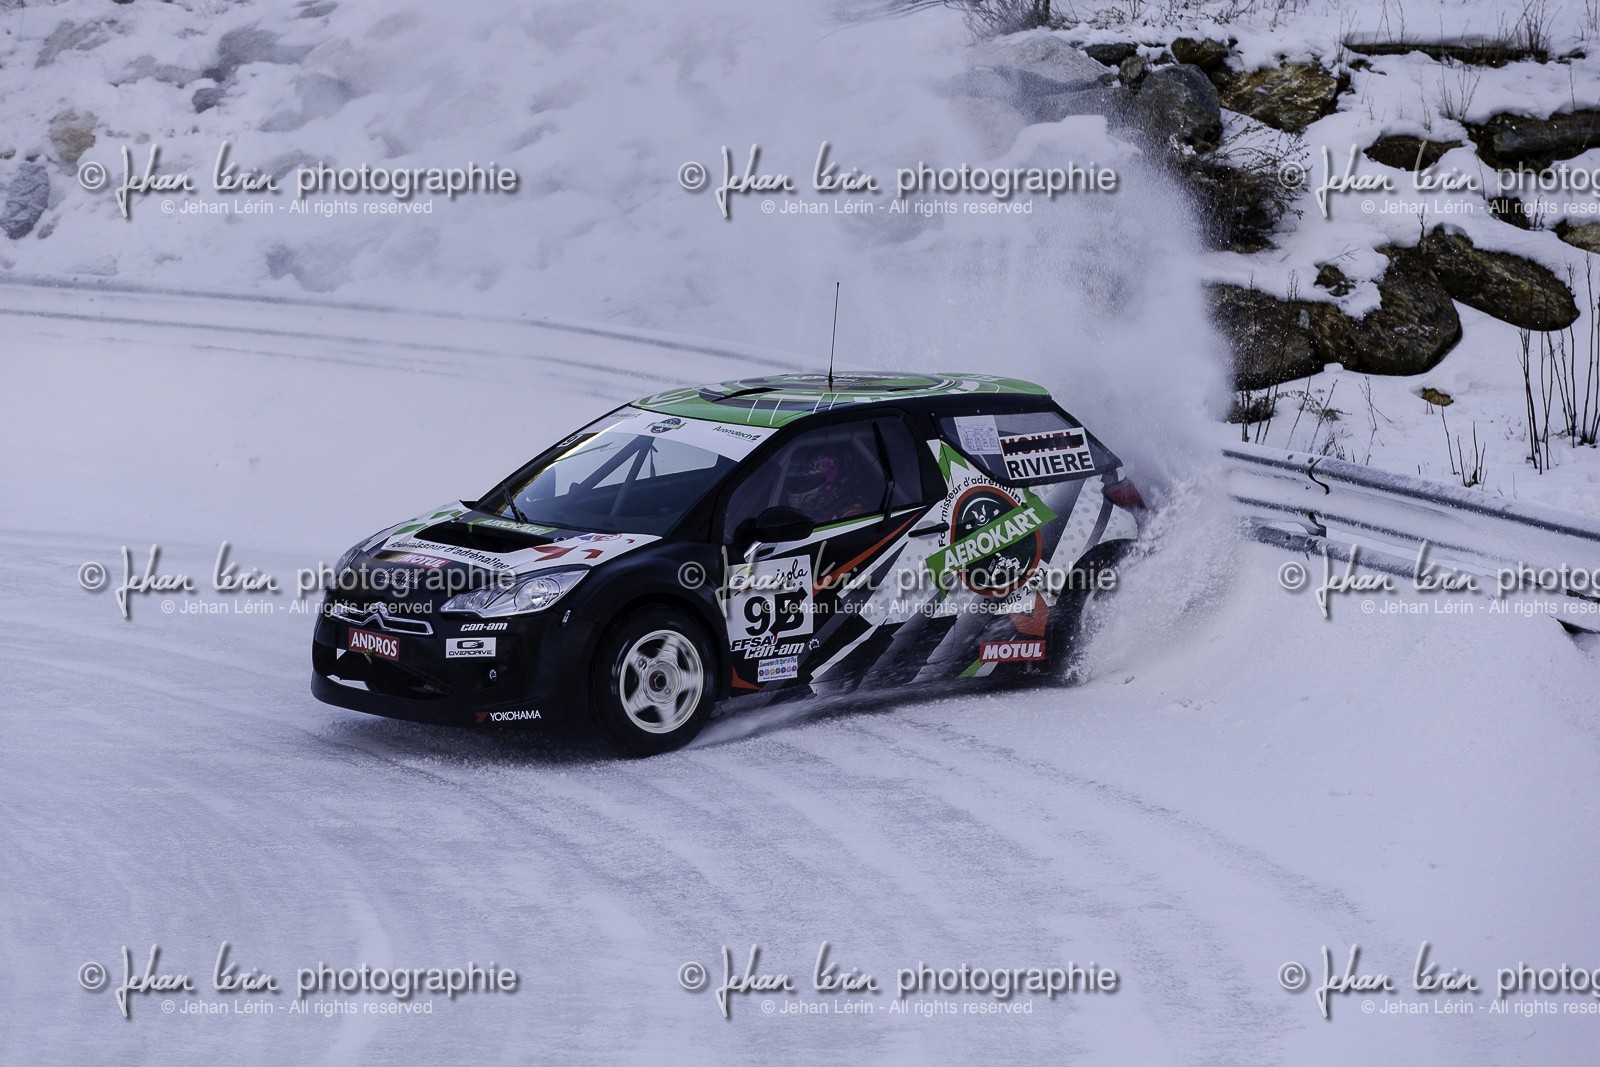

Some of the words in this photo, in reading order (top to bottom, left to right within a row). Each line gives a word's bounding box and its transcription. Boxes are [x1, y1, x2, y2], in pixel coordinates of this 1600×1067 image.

[712, 425, 752, 440] Aromatech
[1006, 451, 1093, 478] RIVIERE
[939, 484, 961, 547] Fornisseur
[944, 507, 1042, 572] AEROKART
[399, 554, 447, 567] MOTUL
[351, 631, 397, 657] ANDROS
[730, 635, 772, 651] FFSA
[982, 643, 1042, 660] MOTUL
[489, 710, 542, 721] YOKOHAMA
